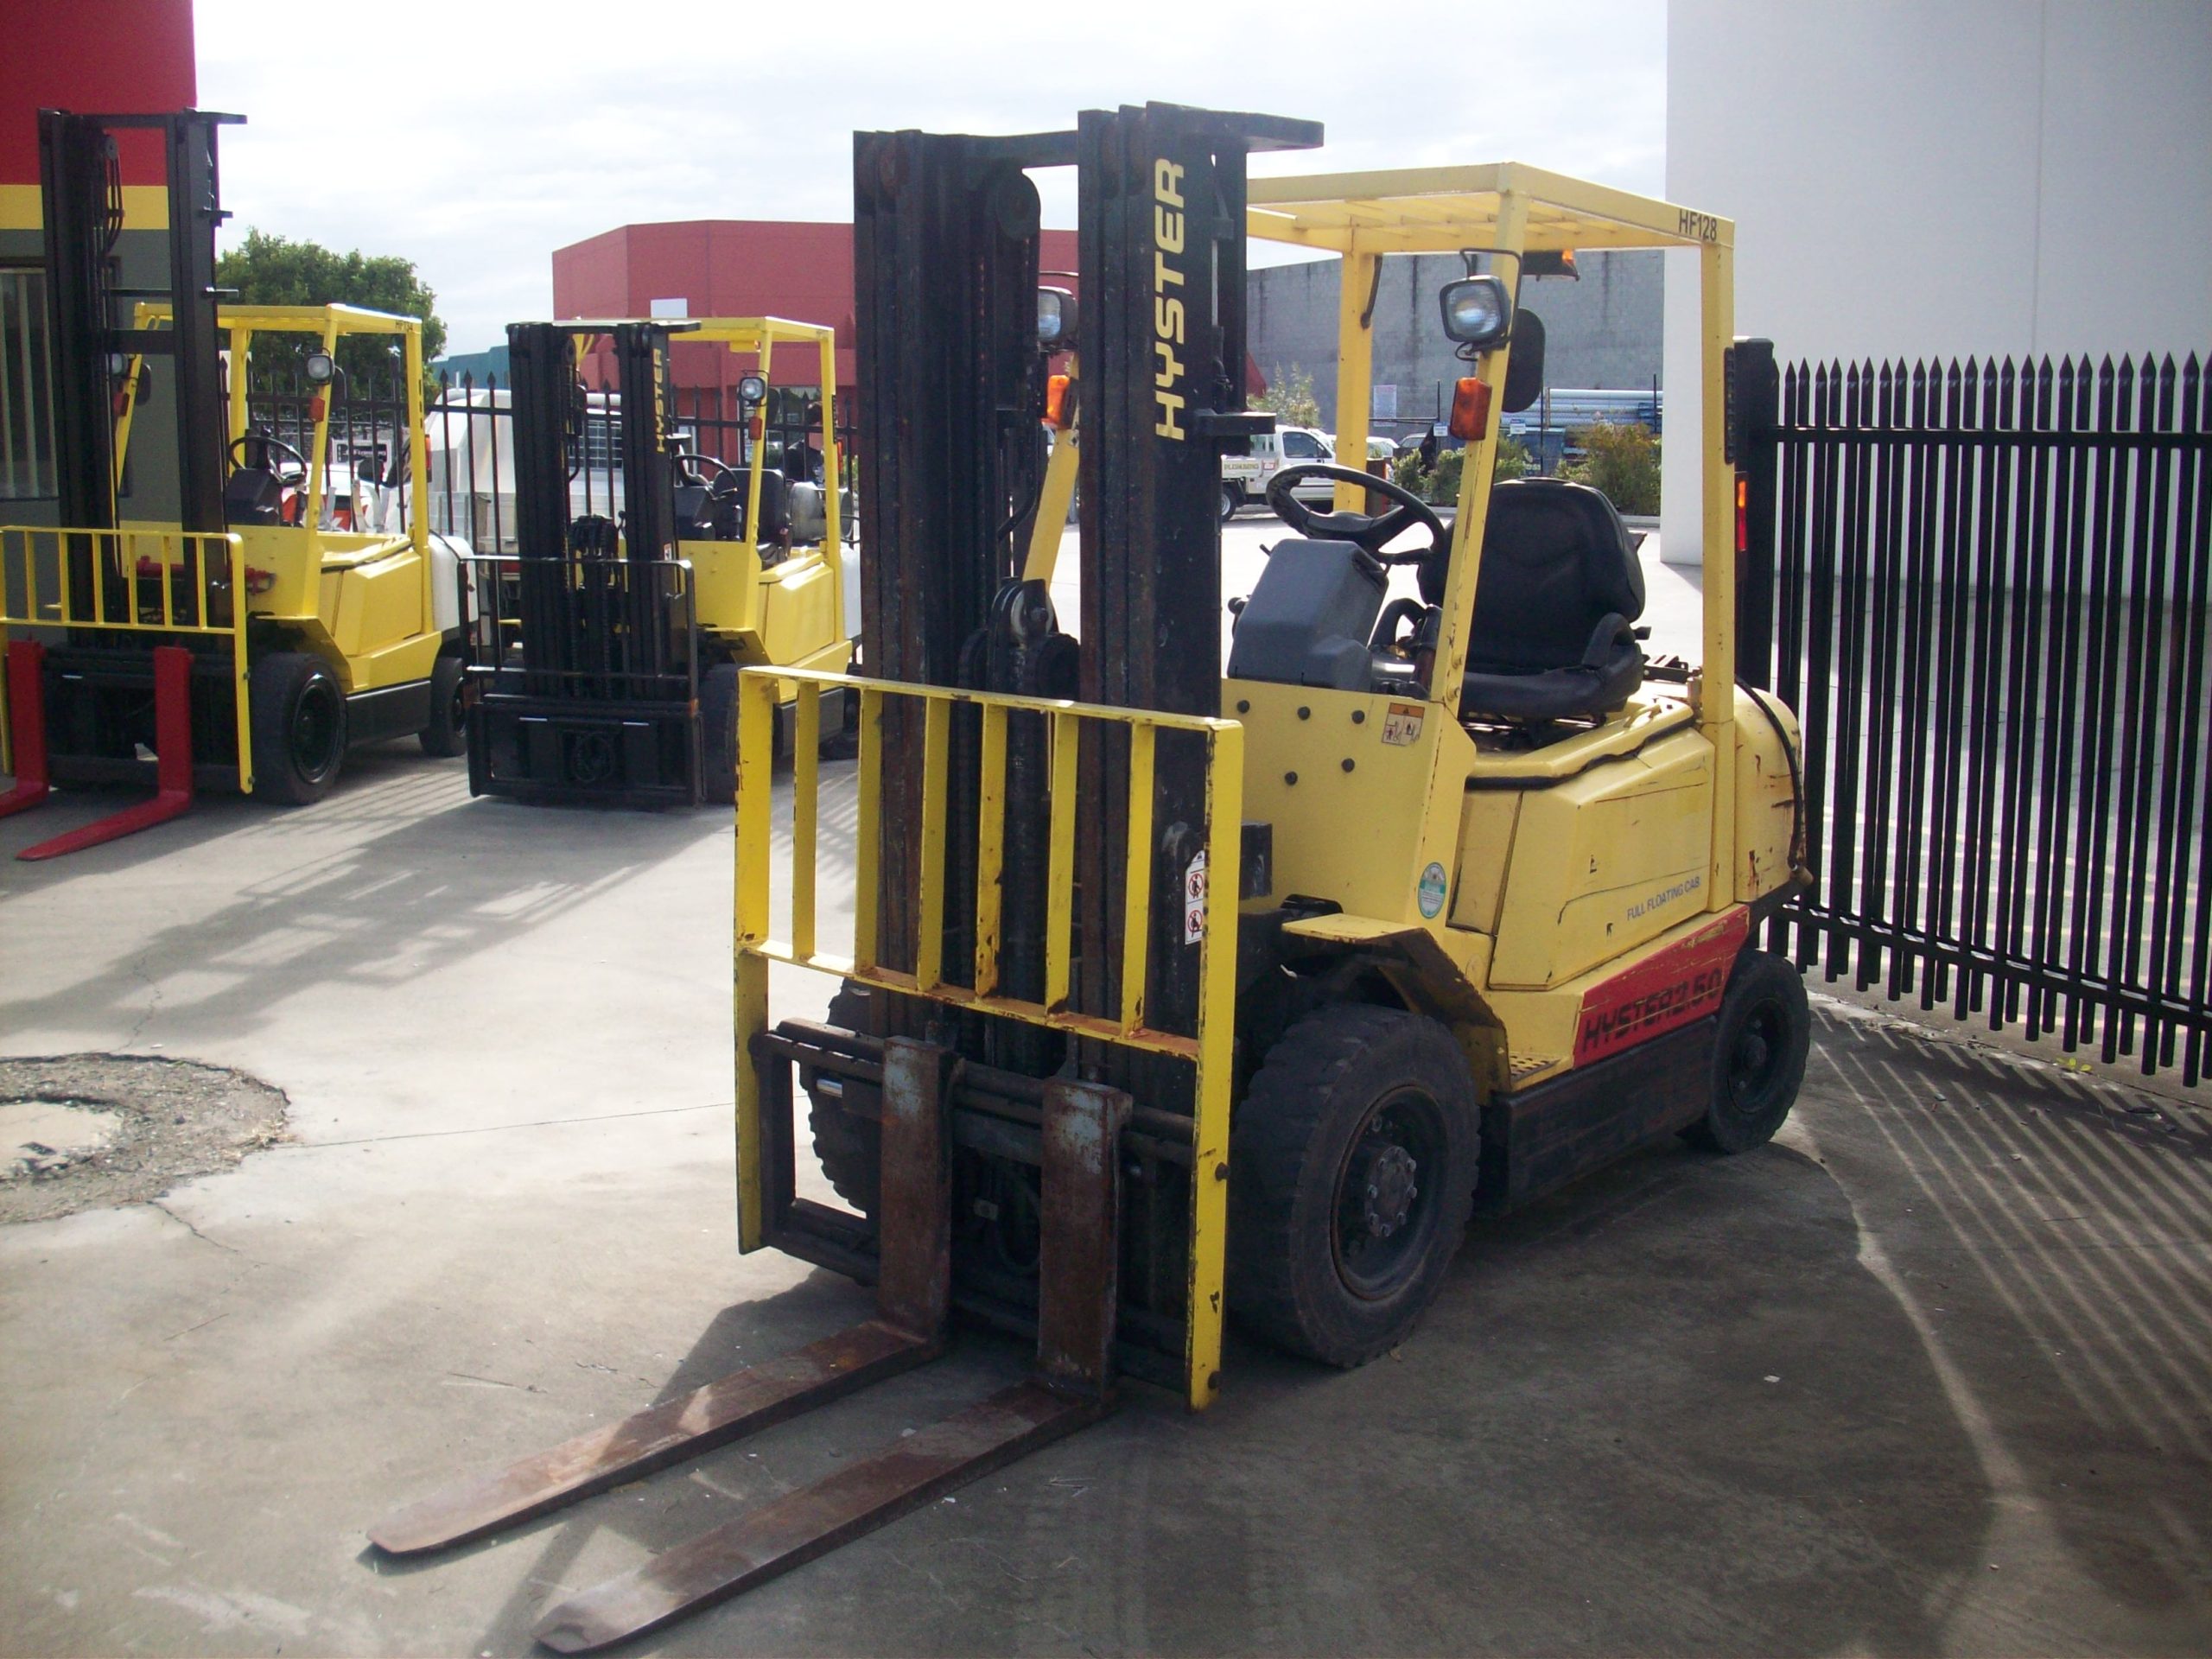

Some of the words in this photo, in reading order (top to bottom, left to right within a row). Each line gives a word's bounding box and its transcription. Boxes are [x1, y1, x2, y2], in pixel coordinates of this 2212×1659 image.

[1679, 208, 1718, 241] HF128
[1154, 158, 1185, 442] HYSTER
[1626, 902, 1646, 921] FULL
[1647, 883, 1684, 912] FLOATING
[1684, 875, 1700, 893] CAB
